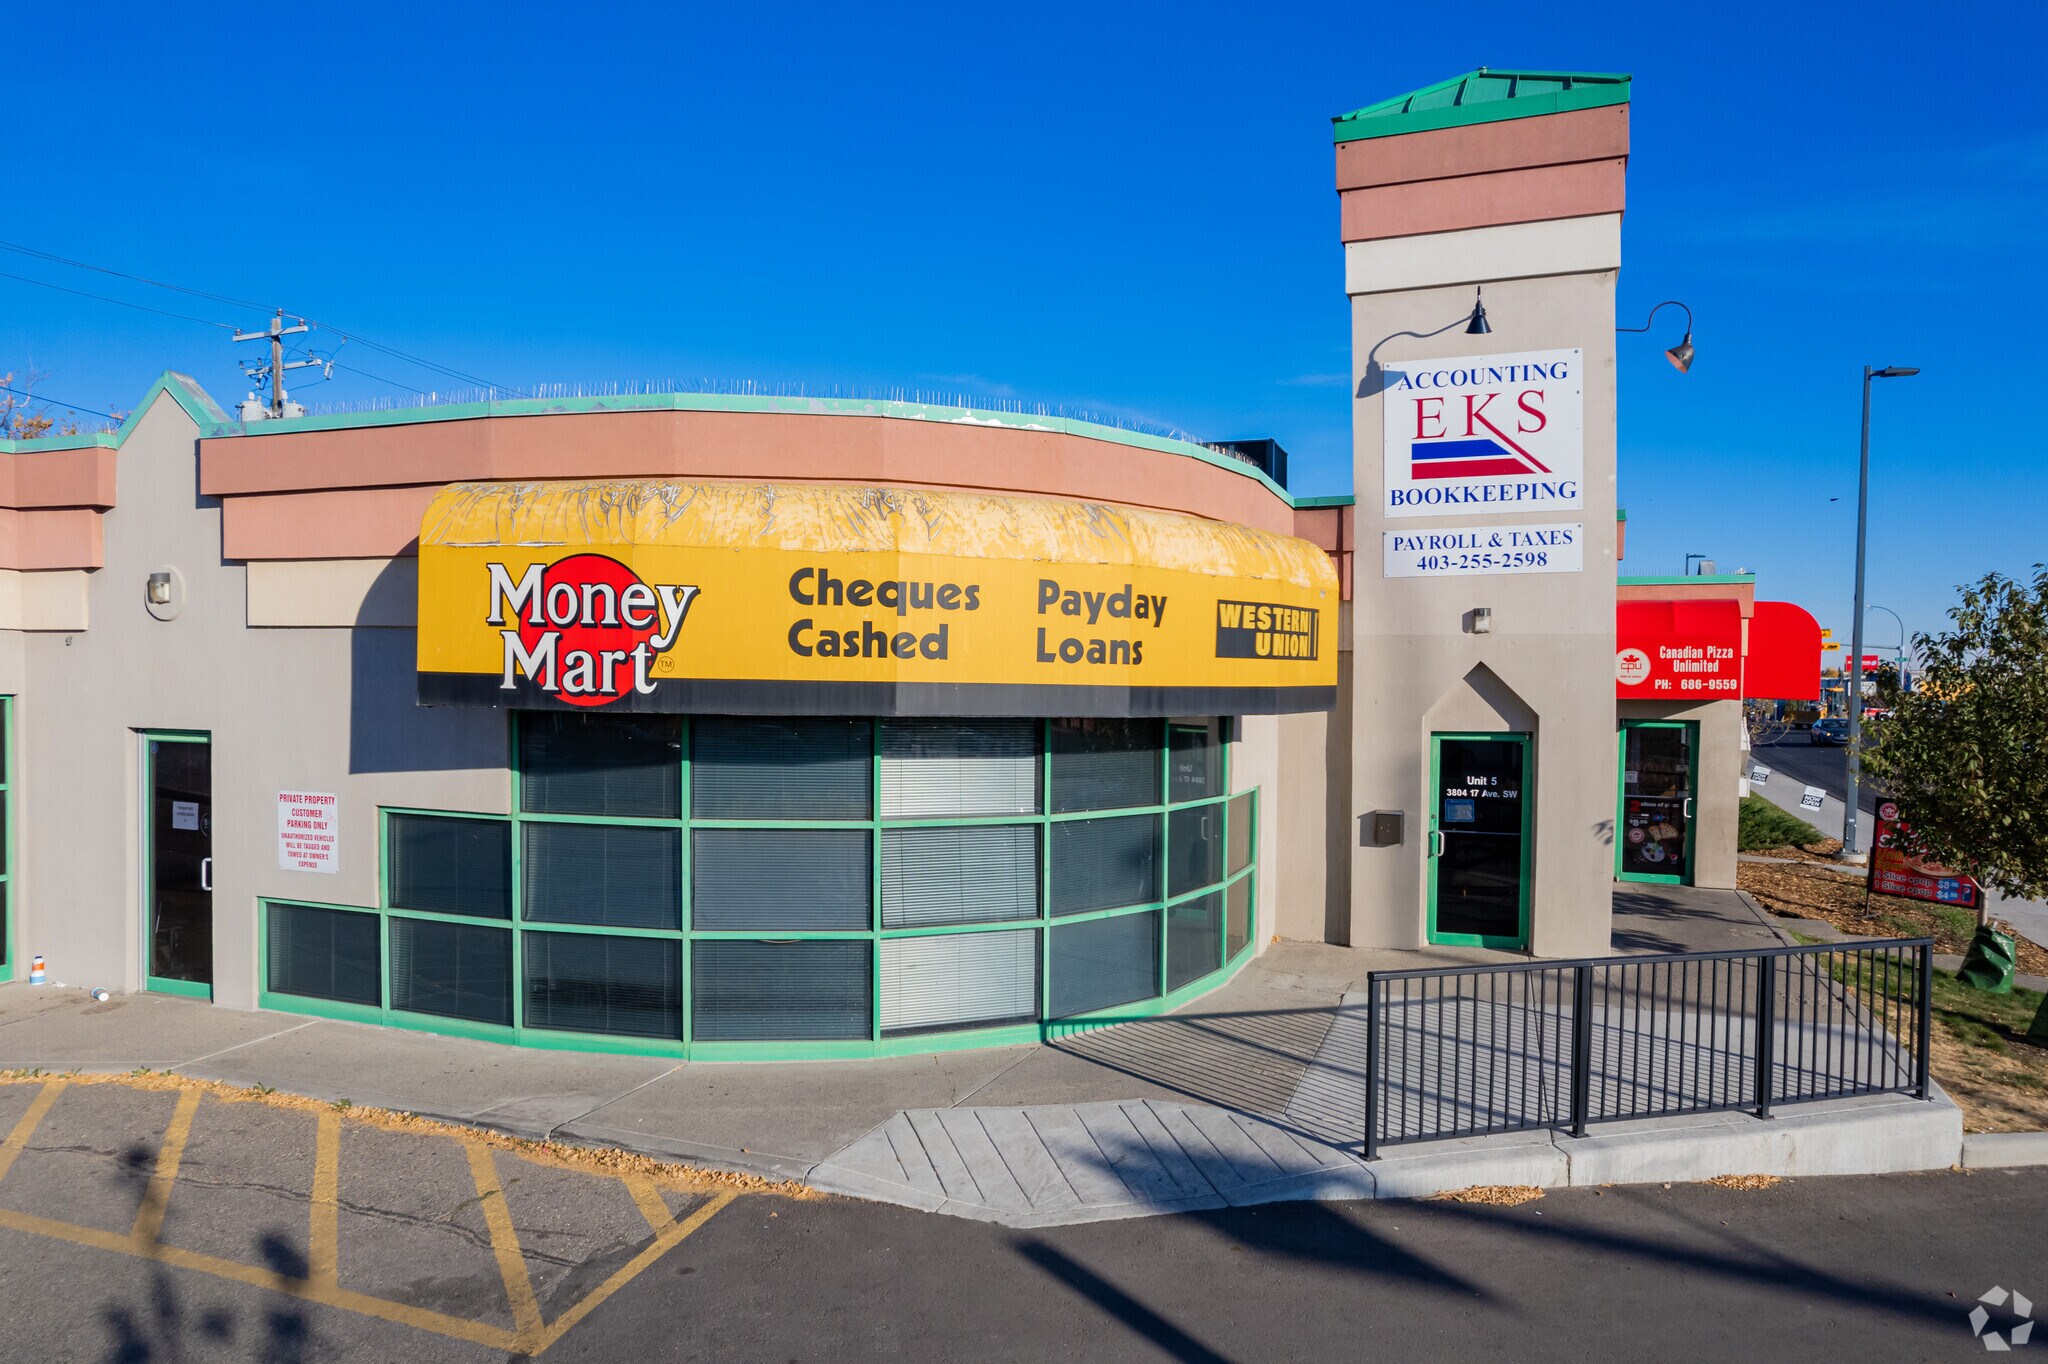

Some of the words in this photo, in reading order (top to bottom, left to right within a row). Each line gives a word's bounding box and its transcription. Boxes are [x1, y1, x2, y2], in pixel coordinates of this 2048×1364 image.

[1397, 361, 1569, 391] ACCOUNTING
[1411, 388, 1553, 474] EKS
[1390, 481, 1577, 506] BOOKKEEPING
[1393, 533, 1482, 551] PAYROLL
[1488, 531, 1503, 548] &
[1509, 529, 1573, 547] TAXES
[1417, 551, 1548, 571] 403-255-2598
[788, 566, 980, 617] Cheques
[486, 562, 701, 652] Money
[1038, 578, 1168, 628] Payday
[1218, 602, 1310, 633] WESTERN
[788, 618, 949, 661] Cashed
[1036, 626, 1143, 665] Loans
[1255, 631, 1310, 658] UNION
[1659, 645, 1704, 659] Canadian
[1706, 645, 1734, 659] Pizza
[499, 630, 660, 697] Mart
[1673, 659, 1719, 673] Unlimited
[1654, 678, 1672, 690] PH:
[1680, 678, 1738, 690] 686-9559
[1466, 775, 1488, 786] Unit
[1490, 776, 1498, 786] 5
[279, 793, 303, 804] PRIVATE
[304, 795, 336, 806] PROPERTY
[1446, 788, 1468, 797] 3804
[1469, 789, 1480, 797] 17
[1481, 789, 1500, 798] Ave.
[1502, 790, 1518, 798] SW
[1804, 794, 1822, 803] NOW
[1630, 799, 1641, 812] 2
[1802, 799, 1820, 807] OPEN
[291, 808, 323, 818] CUSTOMER
[286, 819, 312, 829] PARKING
[313, 821, 328, 830] ONLY
[281, 832, 313, 841] UNAUTHORIZED
[314, 834, 335, 843] VEHICLES
[303, 843, 320, 851] TAGGED
[287, 850, 302, 858] TOWED
[298, 860, 318, 869] EXPENSE
[1883, 871, 1907, 882] Slice
[1881, 881, 1906, 892] Slice
